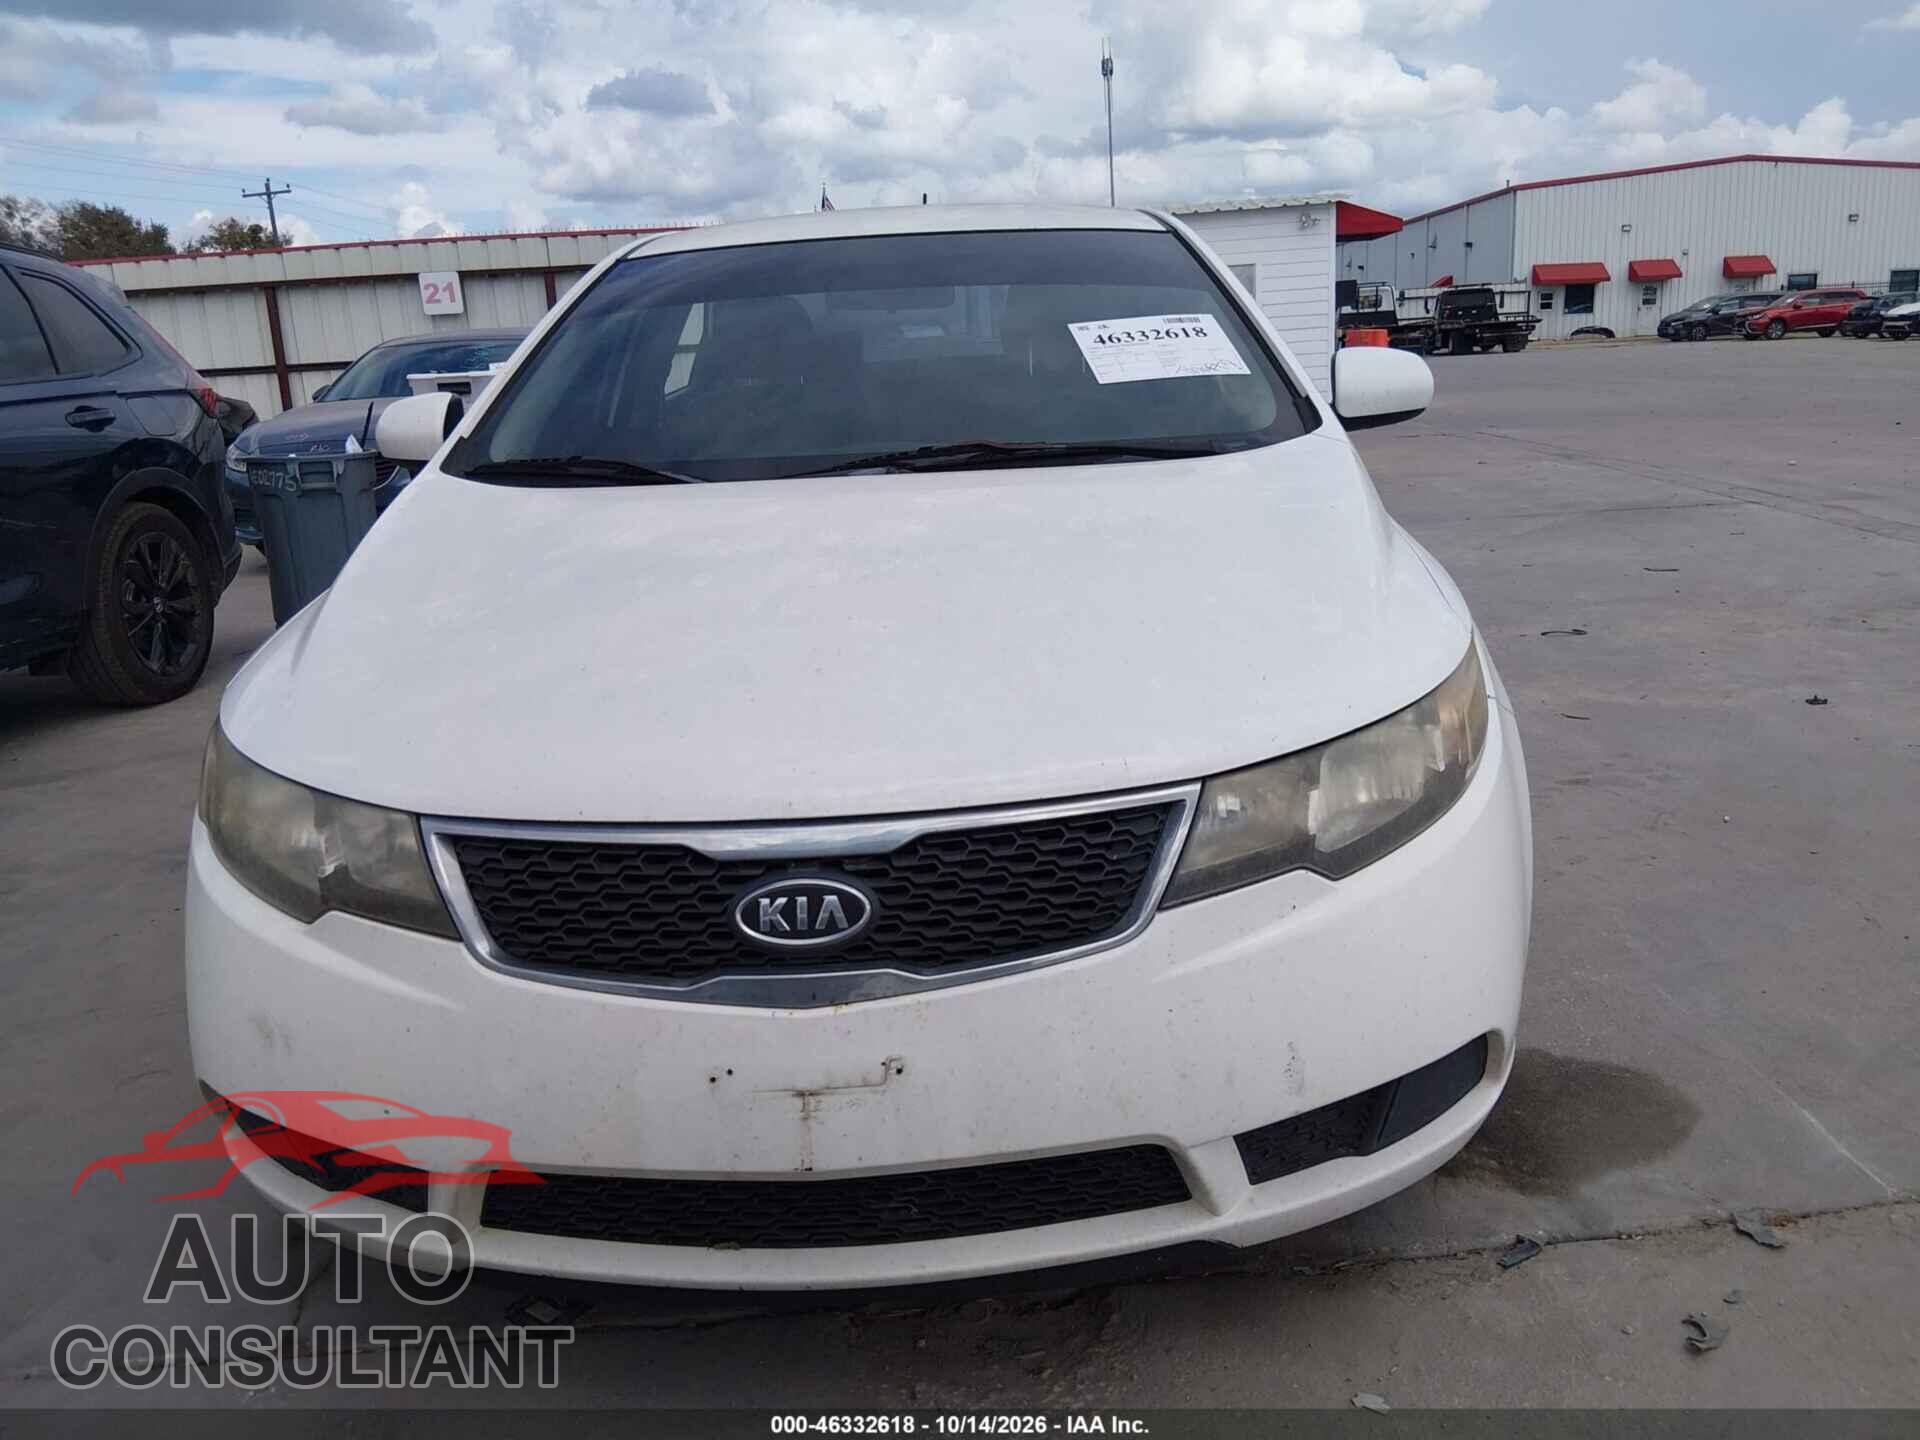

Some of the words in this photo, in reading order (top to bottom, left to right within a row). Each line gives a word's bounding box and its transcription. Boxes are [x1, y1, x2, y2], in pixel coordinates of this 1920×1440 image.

[423, 281, 456, 304] 21
[1093, 326, 1208, 345] 46332618
[758, 895, 849, 932] KIA
